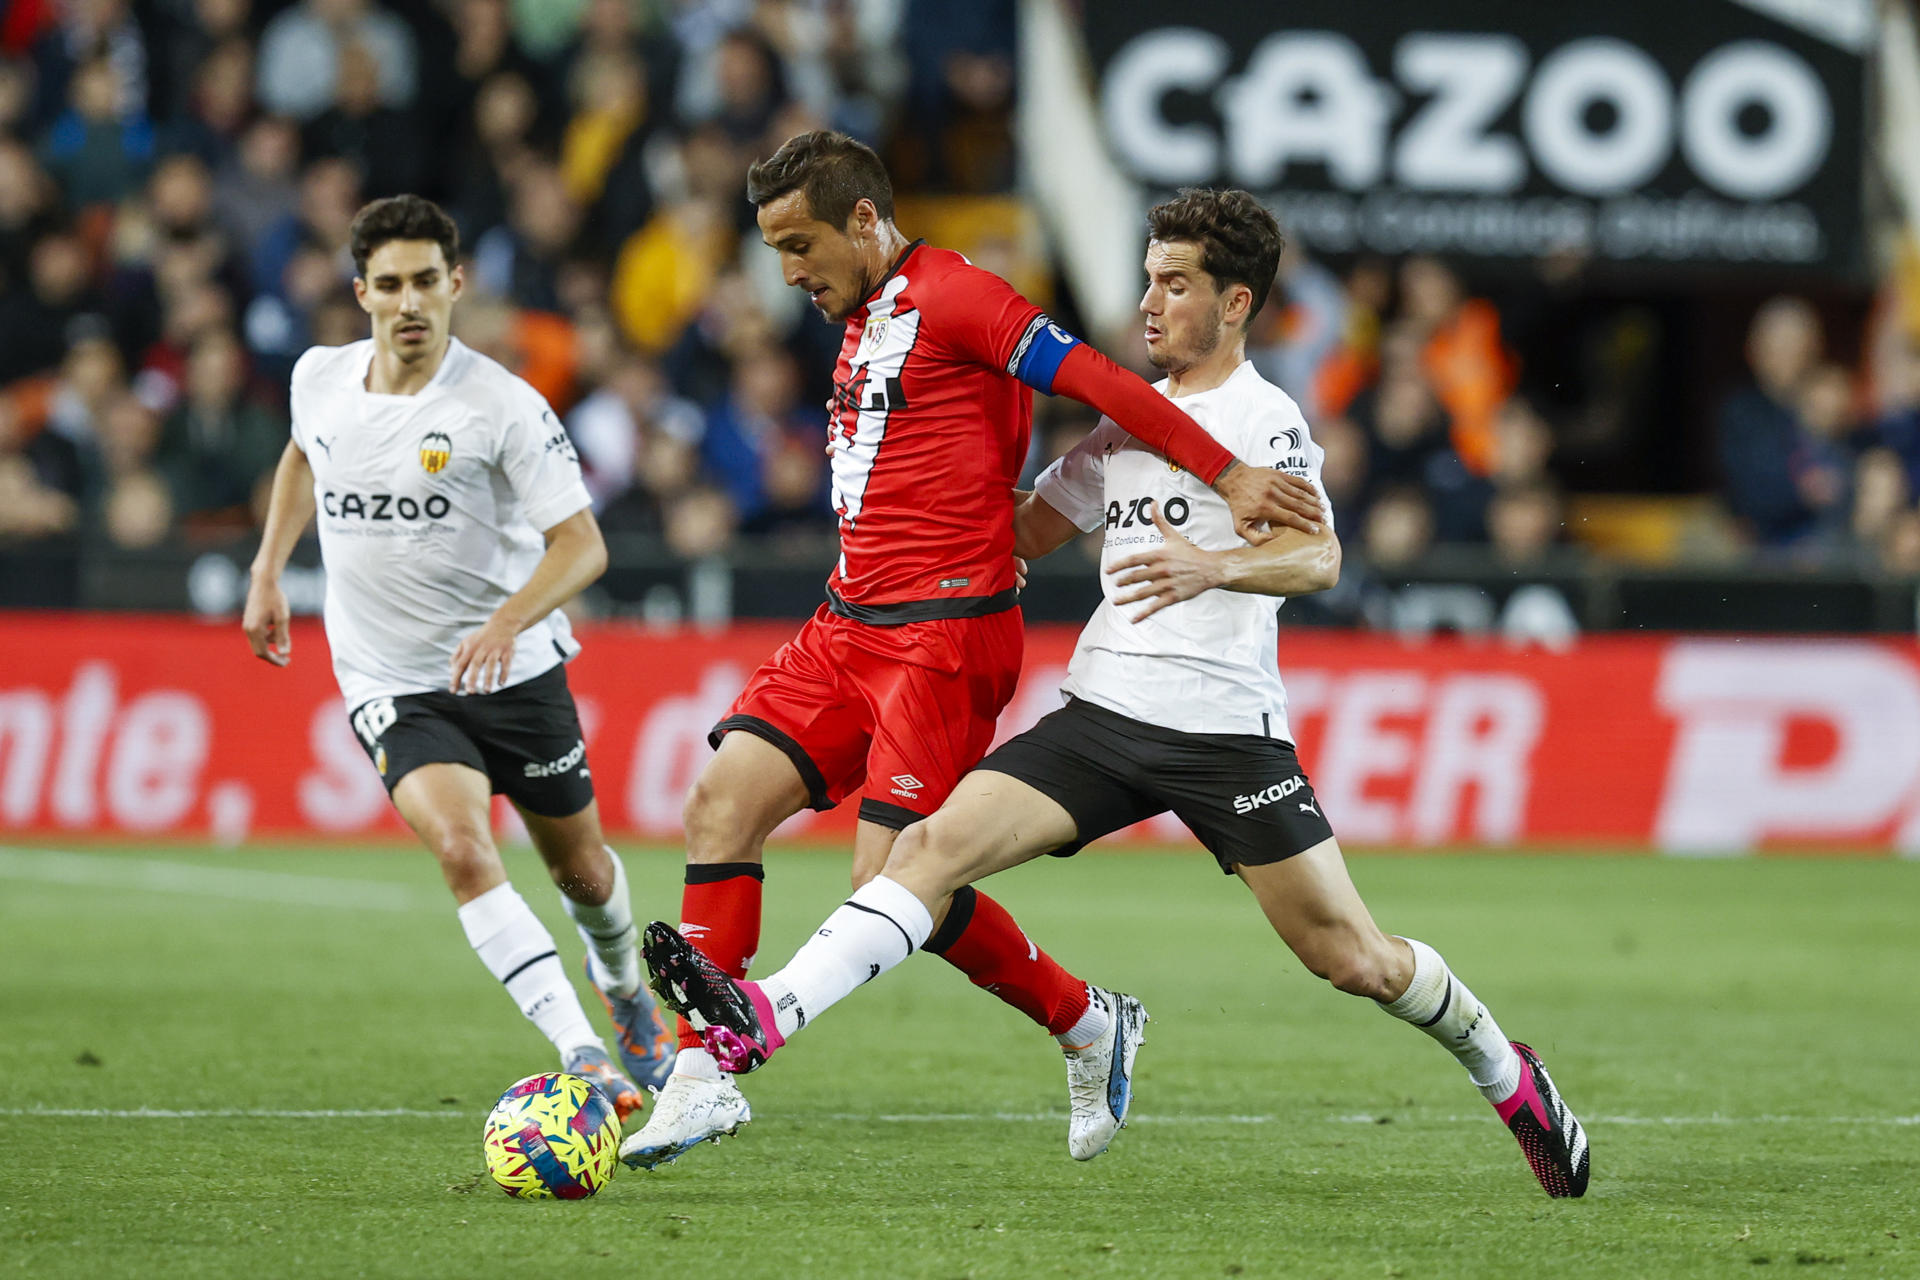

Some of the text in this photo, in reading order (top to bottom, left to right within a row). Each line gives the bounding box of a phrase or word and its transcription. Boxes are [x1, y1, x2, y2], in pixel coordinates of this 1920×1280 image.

[1103, 27, 1831, 198] CAZOO
[1047, 323, 1074, 345] C
[324, 491, 450, 521] CAZOO
[1105, 496, 1190, 530] AZOO
[353, 697, 398, 747] 18
[1656, 638, 1920, 855] P
[890, 787, 918, 800] umbro
[1233, 775, 1306, 815] ŠKODA
[1456, 1006, 1484, 1040] VFC
